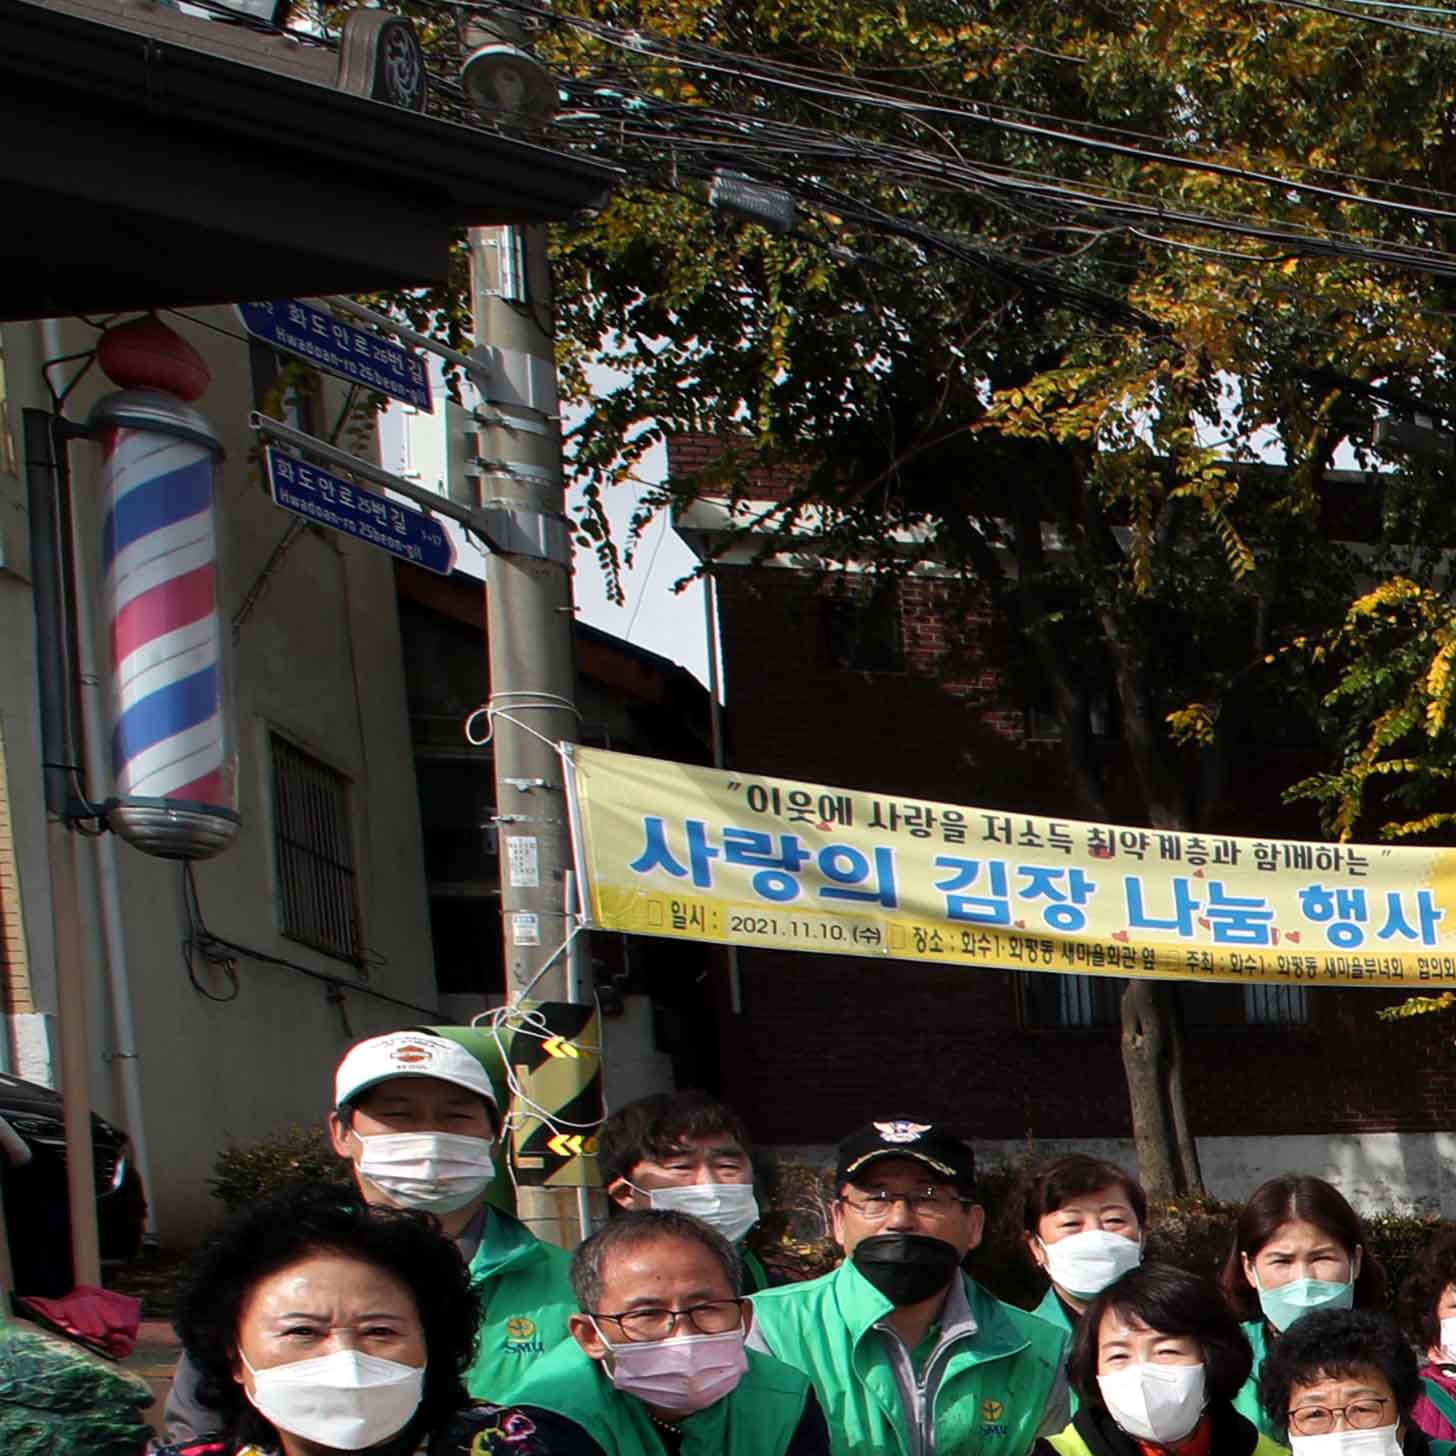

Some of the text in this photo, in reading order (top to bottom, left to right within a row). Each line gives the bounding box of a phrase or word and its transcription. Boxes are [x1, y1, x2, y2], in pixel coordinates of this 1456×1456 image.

[867, 801, 968, 845] 사랑을
[981, 814, 1074, 854] 저소득
[1087, 827, 1242, 866] 취약계층과
[629, 816, 1446, 948] 사랑의 김장 나눔 행사
[671, 901, 706, 932] 일시
[912, 927, 943, 954] 장소
[1061, 942, 1137, 969] 새마을회관
[1186, 951, 1215, 974] 주최
[1323, 956, 1404, 981] 새마을부녀회
